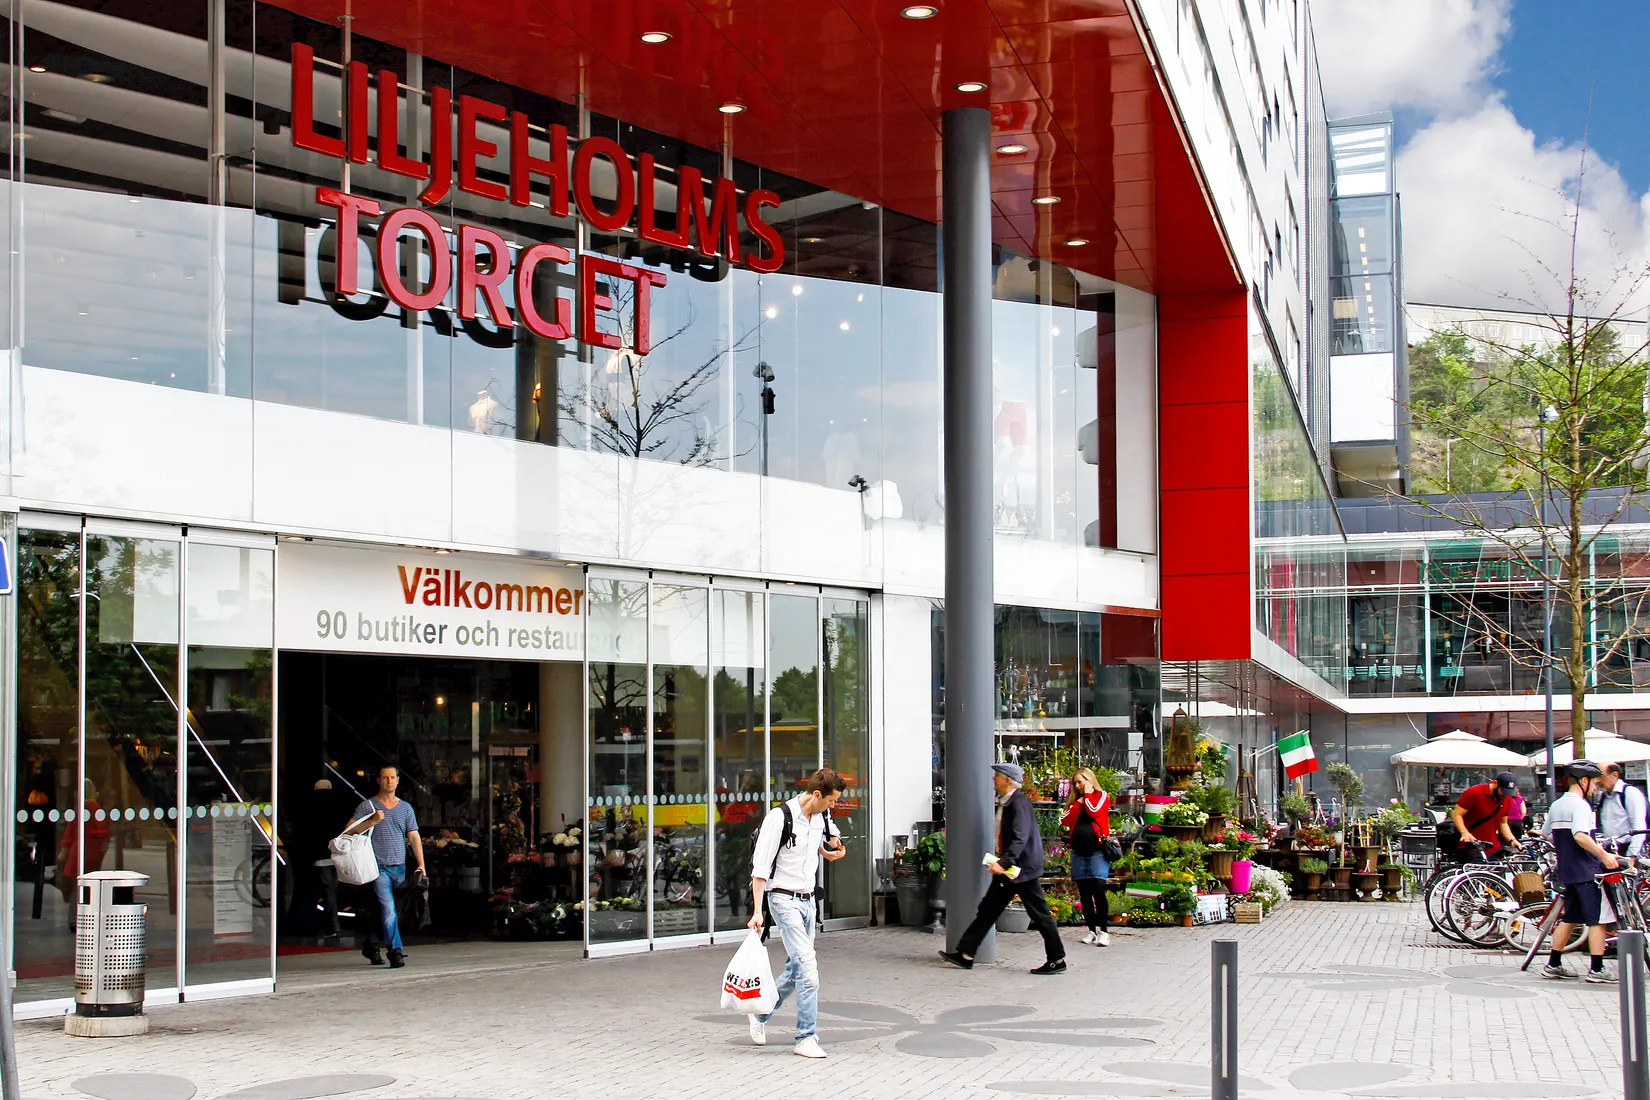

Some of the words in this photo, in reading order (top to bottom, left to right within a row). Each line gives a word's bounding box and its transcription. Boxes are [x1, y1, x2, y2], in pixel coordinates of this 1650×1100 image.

[291, 42, 784, 274] LILJEHOLMS
[316, 186, 667, 356] TORGET
[1478, 557, 1561, 580] SPORTSBR
[316, 610, 347, 640] 90
[357, 612, 448, 645] butiker
[455, 619, 499, 647] och
